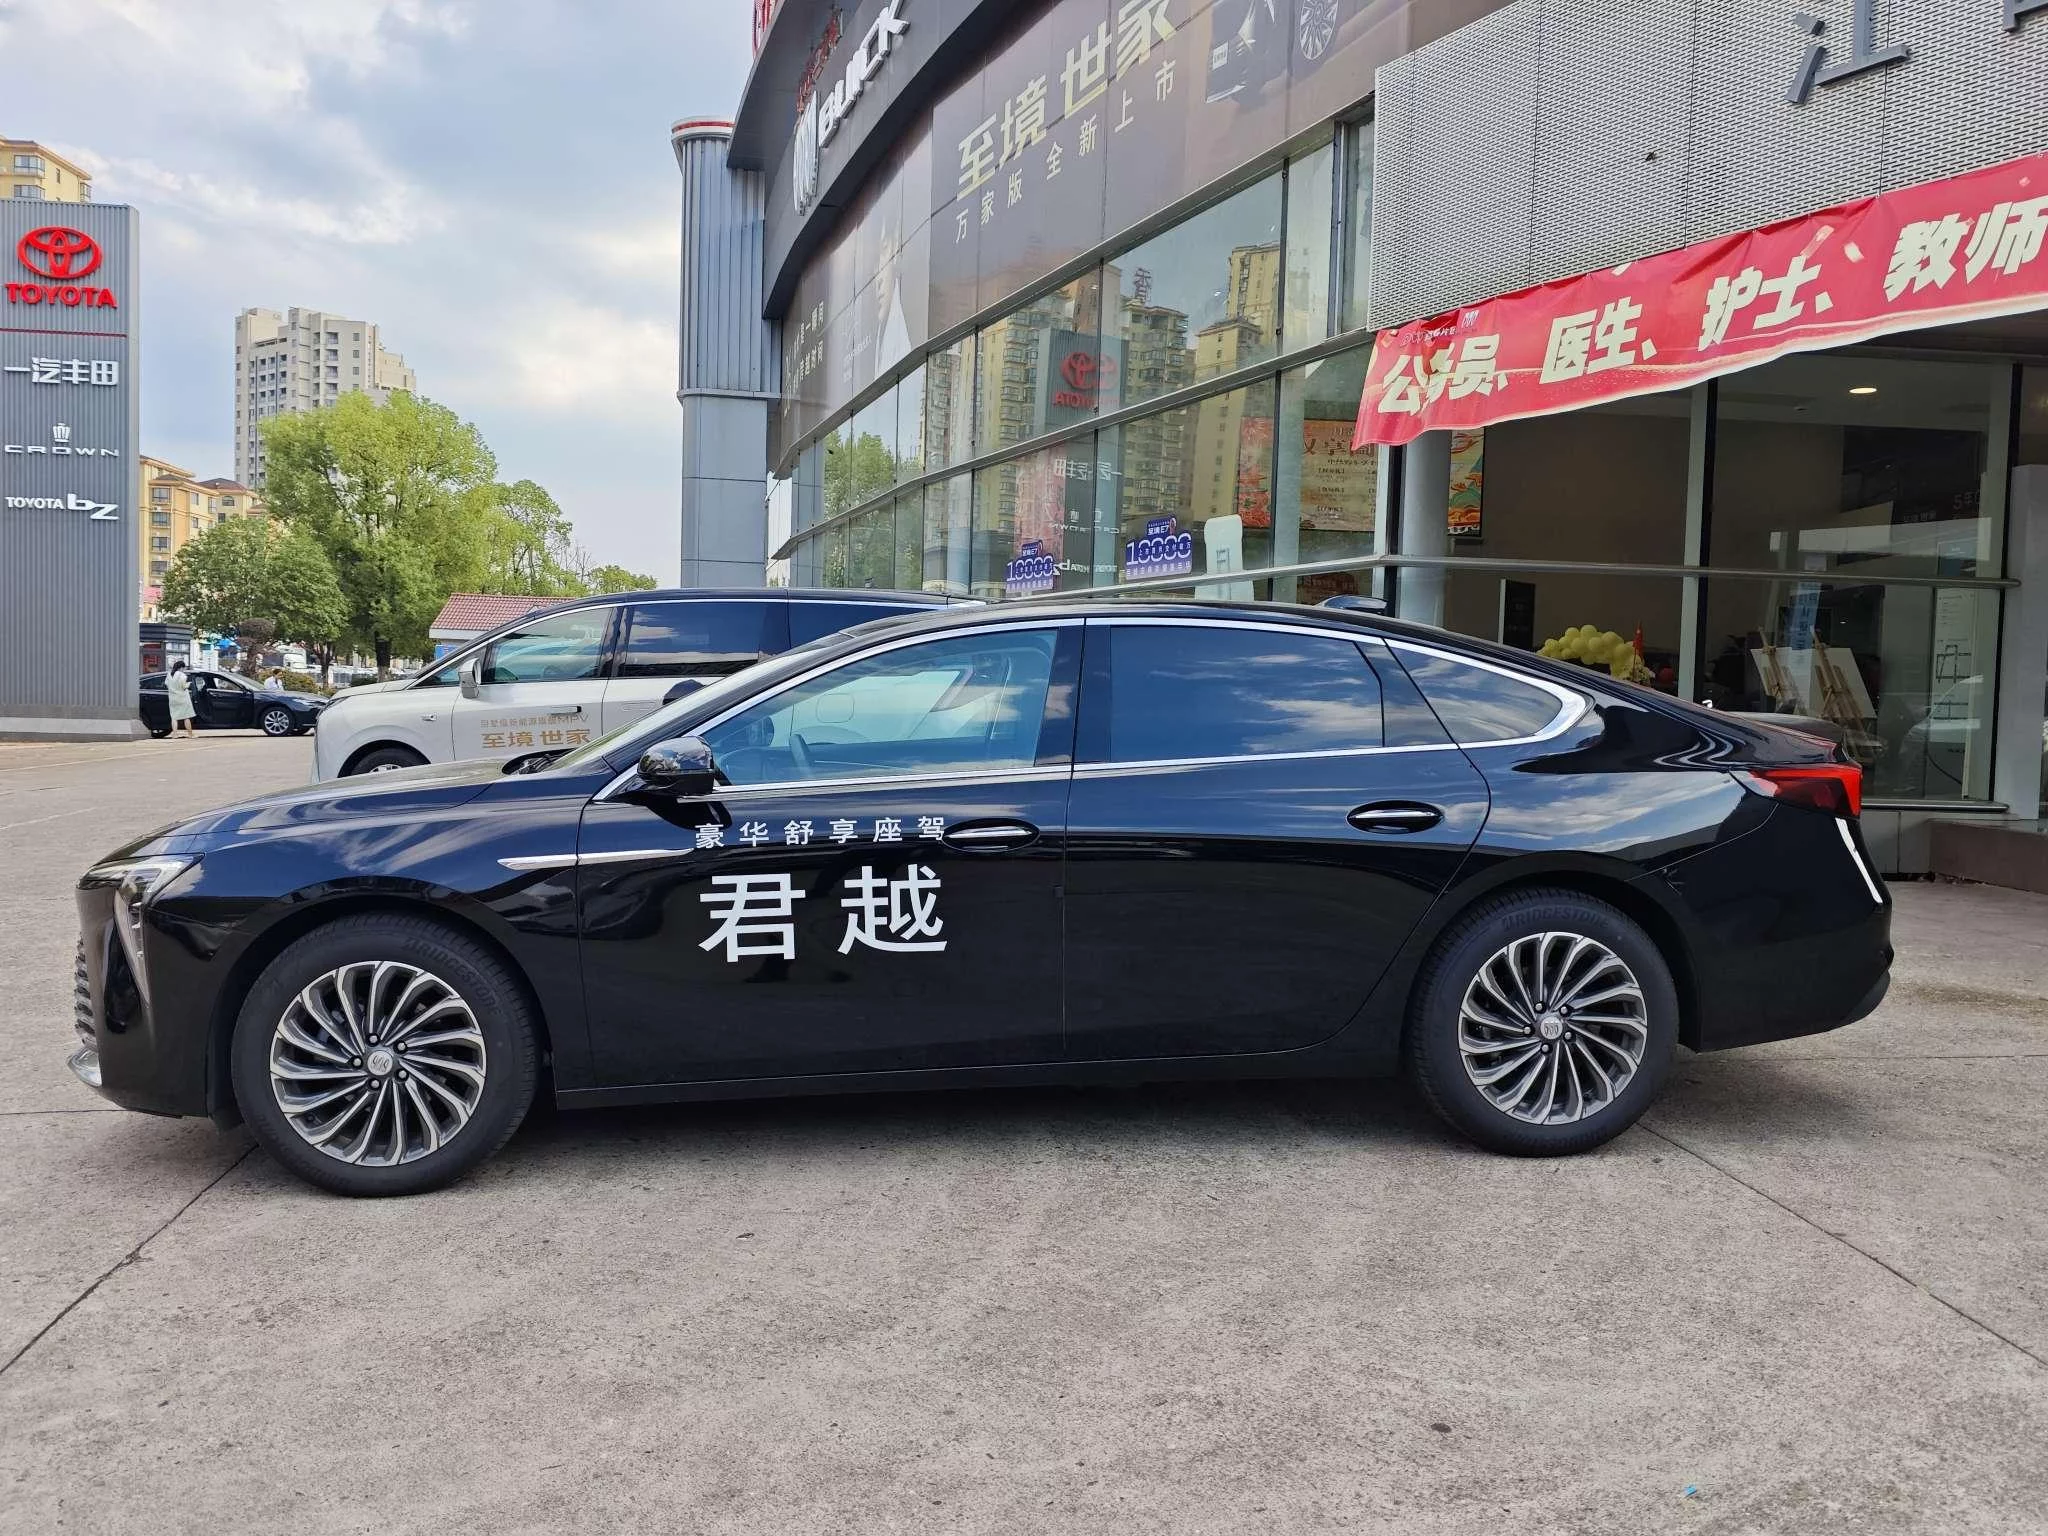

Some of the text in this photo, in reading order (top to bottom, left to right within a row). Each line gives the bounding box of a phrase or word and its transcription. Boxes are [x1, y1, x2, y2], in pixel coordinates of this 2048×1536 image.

[956, 60, 1176, 244] 万家版全新上市
[5, 283, 118, 308] TOYOTA
[3, 357, 119, 386] 一汽丰田
[4, 445, 119, 457] CROWN
[6, 496, 65, 510] TOYOTA
[1126, 532, 1192, 566] 10000
[1006, 555, 1053, 582] 10000
[481, 728, 591, 749] 至境世家
[695, 815, 945, 849] 豪华舒享座驾
[697, 863, 948, 963] 君越
